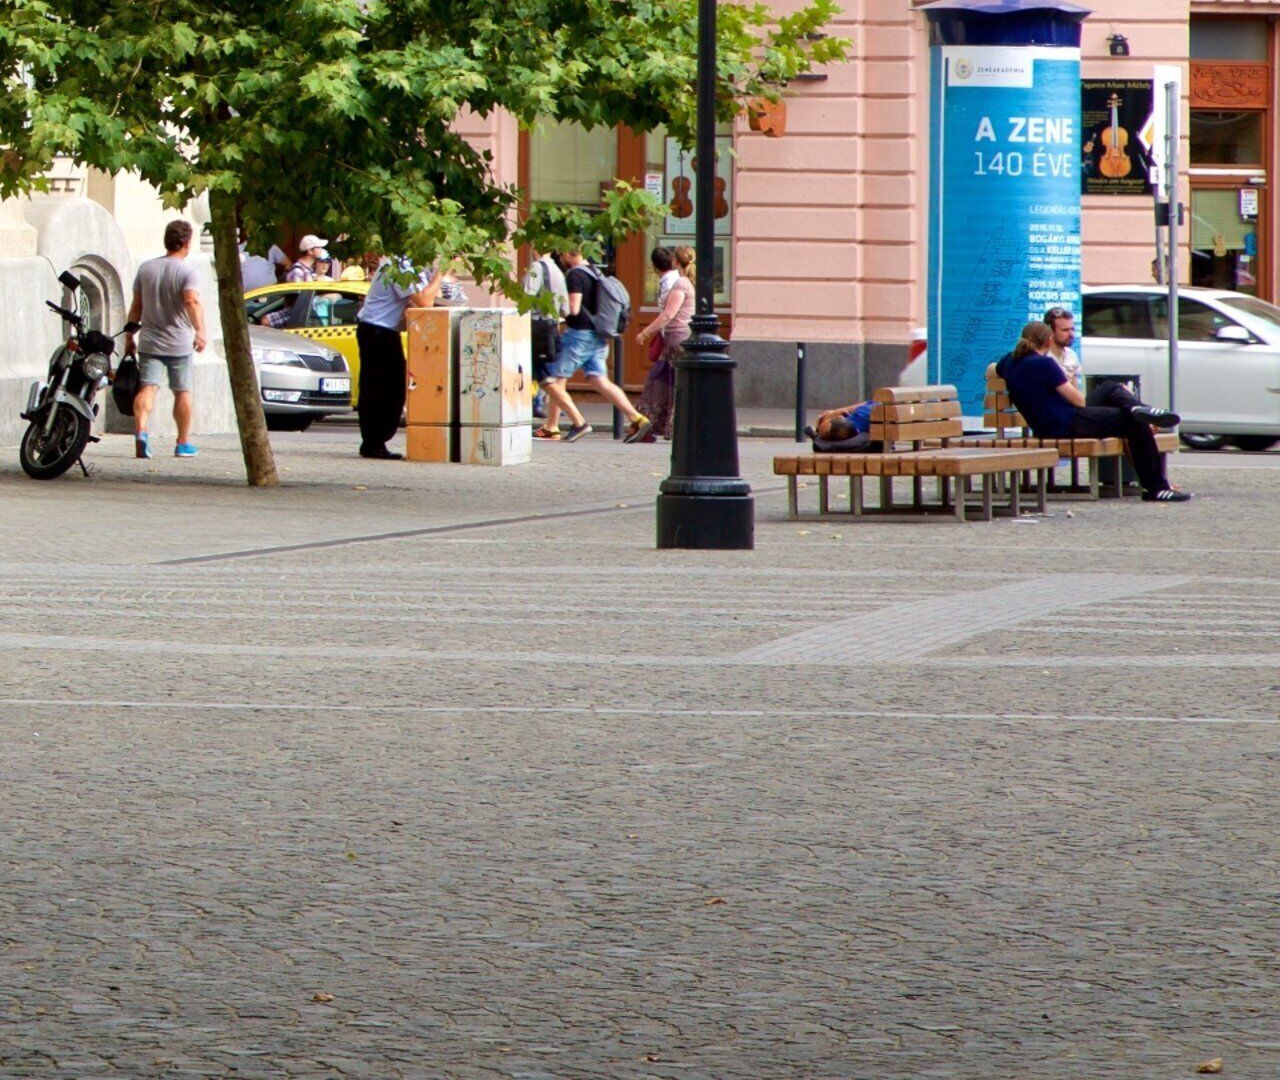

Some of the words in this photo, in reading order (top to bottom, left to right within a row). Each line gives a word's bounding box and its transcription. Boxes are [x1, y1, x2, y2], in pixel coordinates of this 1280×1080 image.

[974, 116, 997, 142] A
[1008, 116, 1073, 144] ZENE
[973, 152, 1023, 176] 140
[1032, 146, 1073, 178] ÉVE
